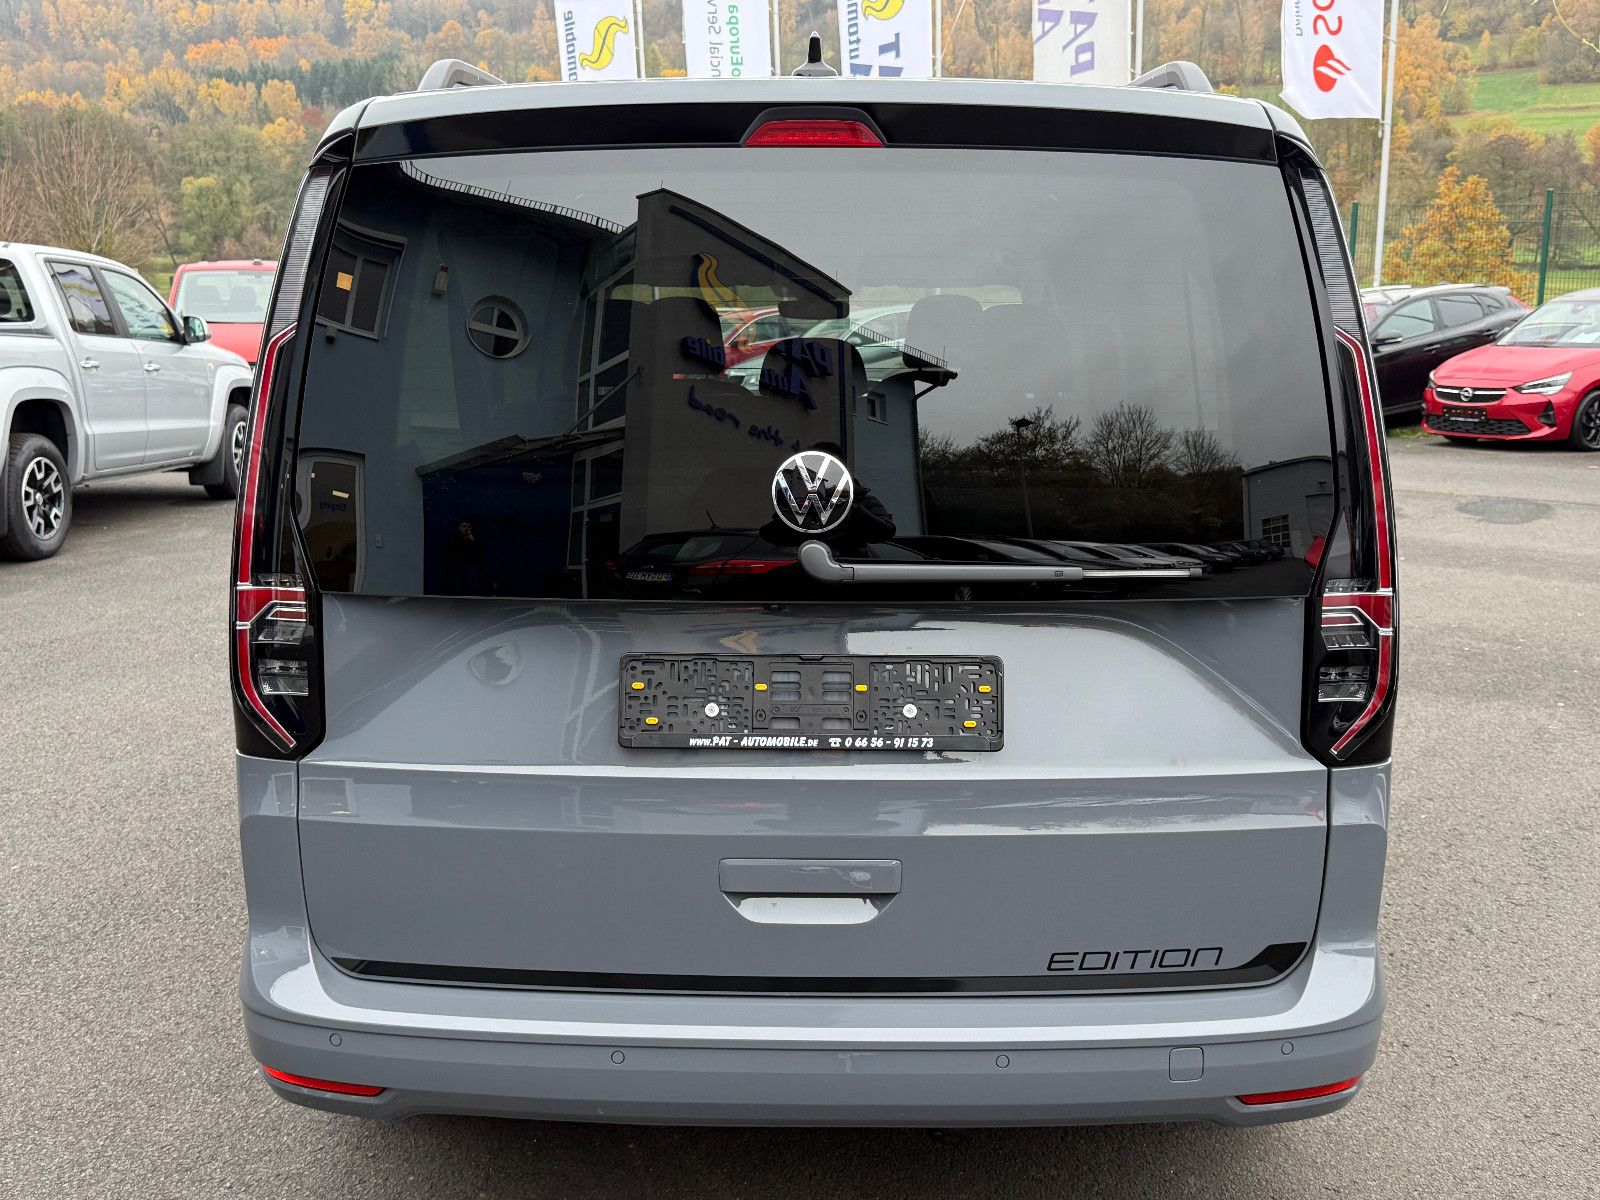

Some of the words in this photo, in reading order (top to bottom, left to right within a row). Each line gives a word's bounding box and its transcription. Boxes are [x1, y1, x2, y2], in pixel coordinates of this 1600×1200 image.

[844, 737, 853, 747] 0
[854, 737, 868, 747] 66
[870, 737, 884, 747] 56
[893, 737, 905, 748] 91
[907, 737, 919, 748] 15
[921, 737, 934, 748] 73
[1047, 946, 1224, 972] EDITION
